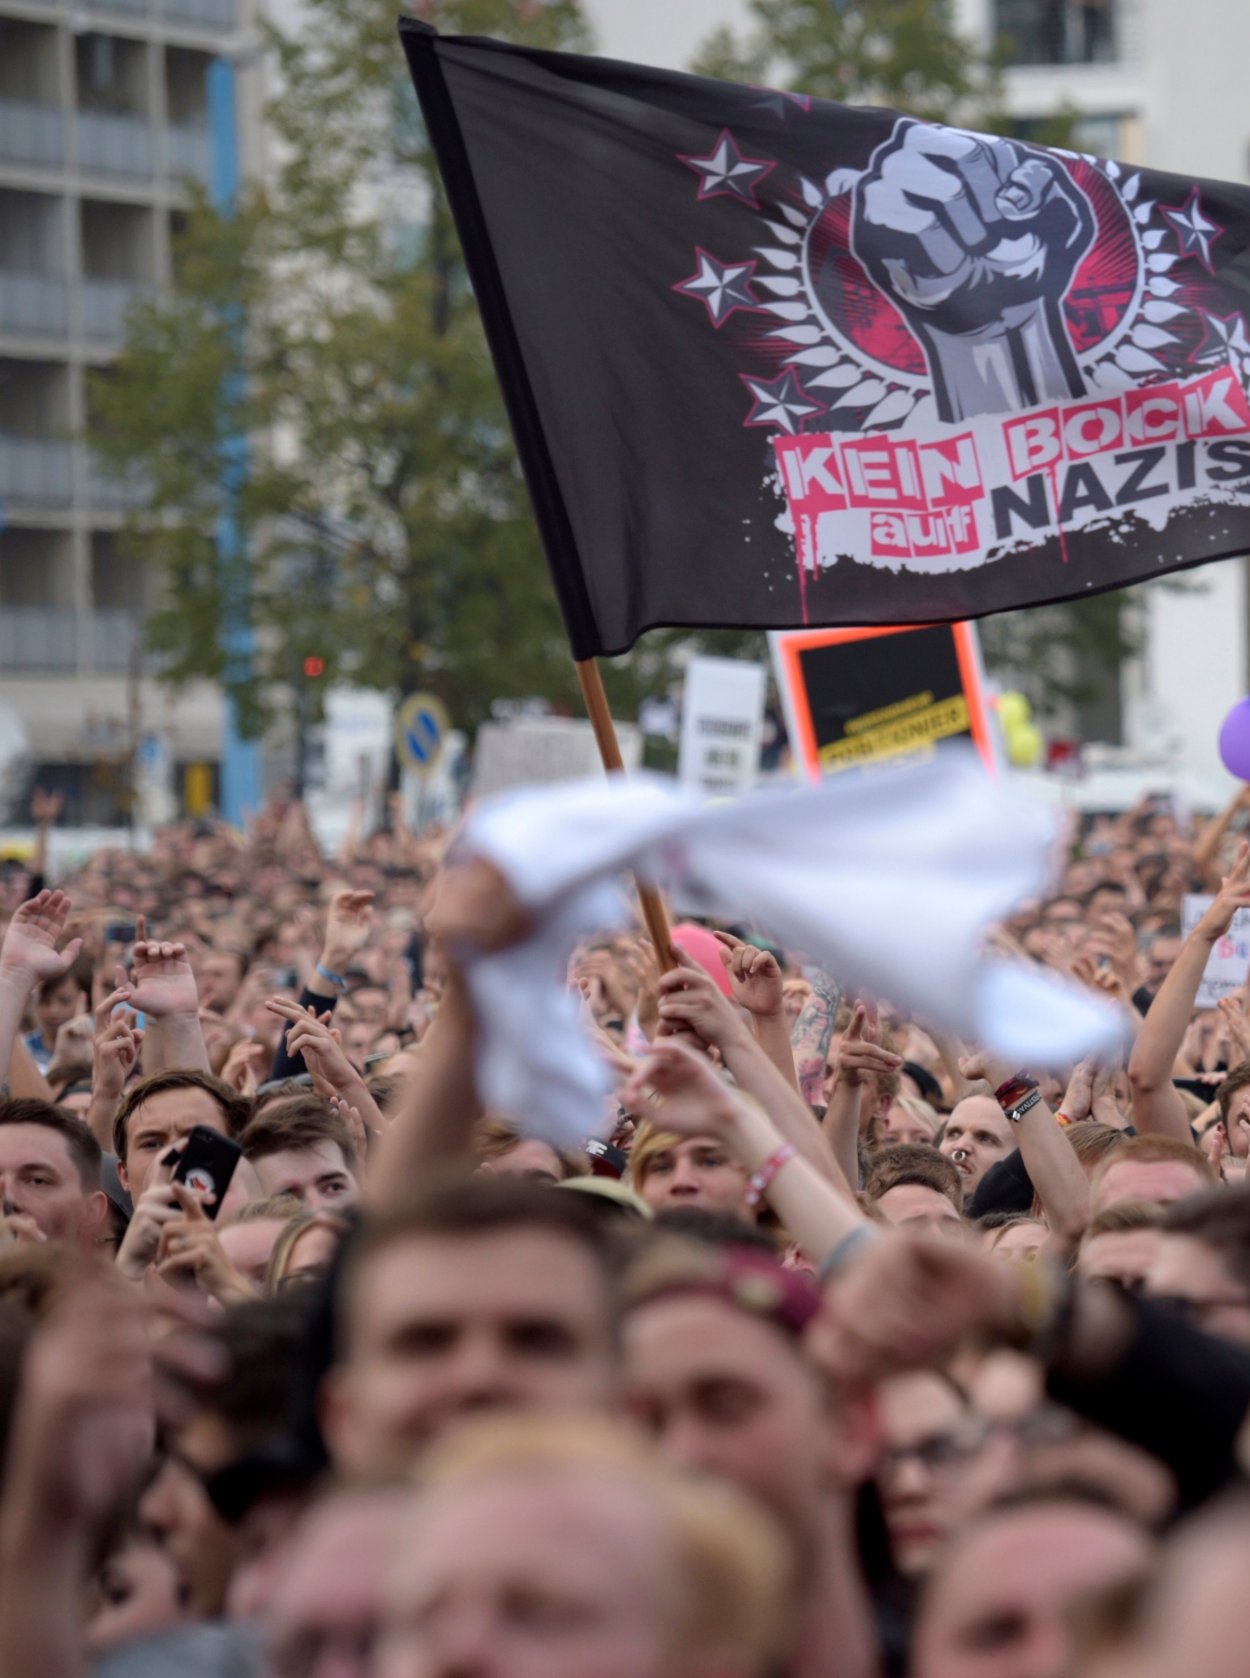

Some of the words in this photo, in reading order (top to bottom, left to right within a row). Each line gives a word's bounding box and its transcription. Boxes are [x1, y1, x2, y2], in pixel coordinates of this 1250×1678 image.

[782, 437, 983, 500] KEIN
[1007, 376, 1247, 476] BOCK
[871, 504, 972, 548] auf
